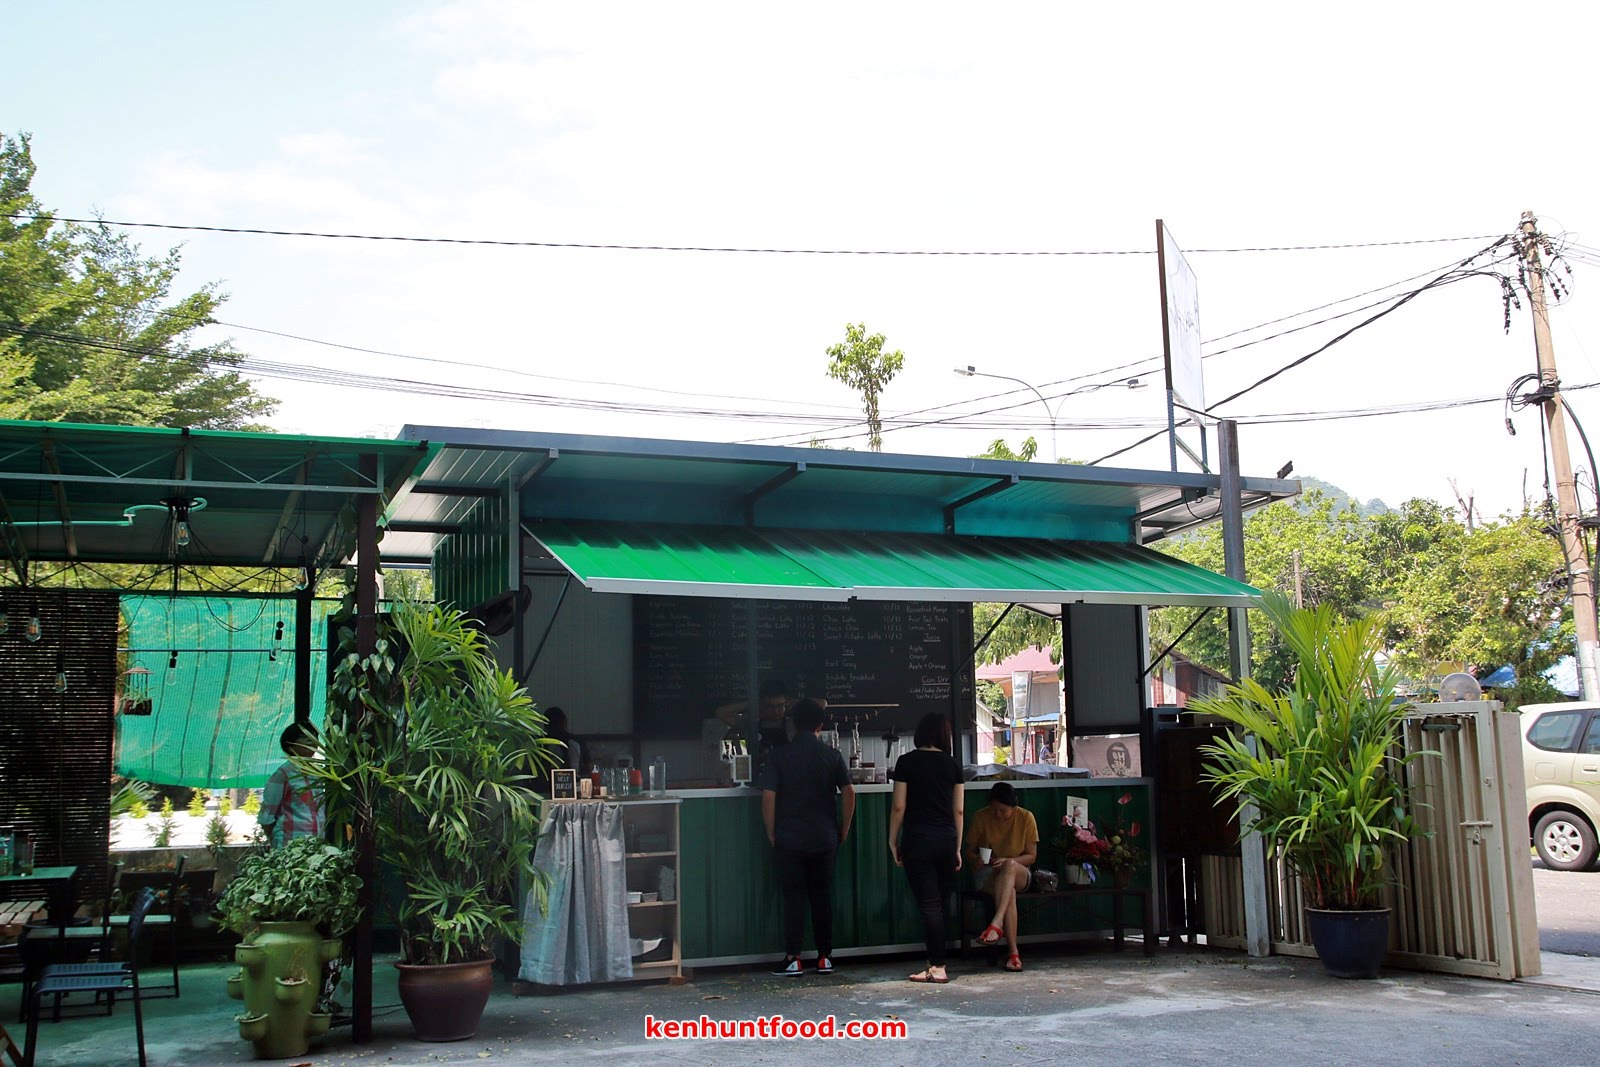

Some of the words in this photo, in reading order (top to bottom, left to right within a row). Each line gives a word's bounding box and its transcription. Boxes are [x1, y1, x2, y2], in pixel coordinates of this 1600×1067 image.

[884, 623, 903, 632] 11/12
[909, 644, 923, 653] Apple
[825, 658, 839, 667] Earl
[841, 659, 857, 670] Grey
[909, 662, 922, 671] Apple
[928, 662, 946, 670] Orange
[849, 673, 875, 682] Breakfast
[826, 691, 844, 699] Green
[846, 690, 856, 699] Tea
